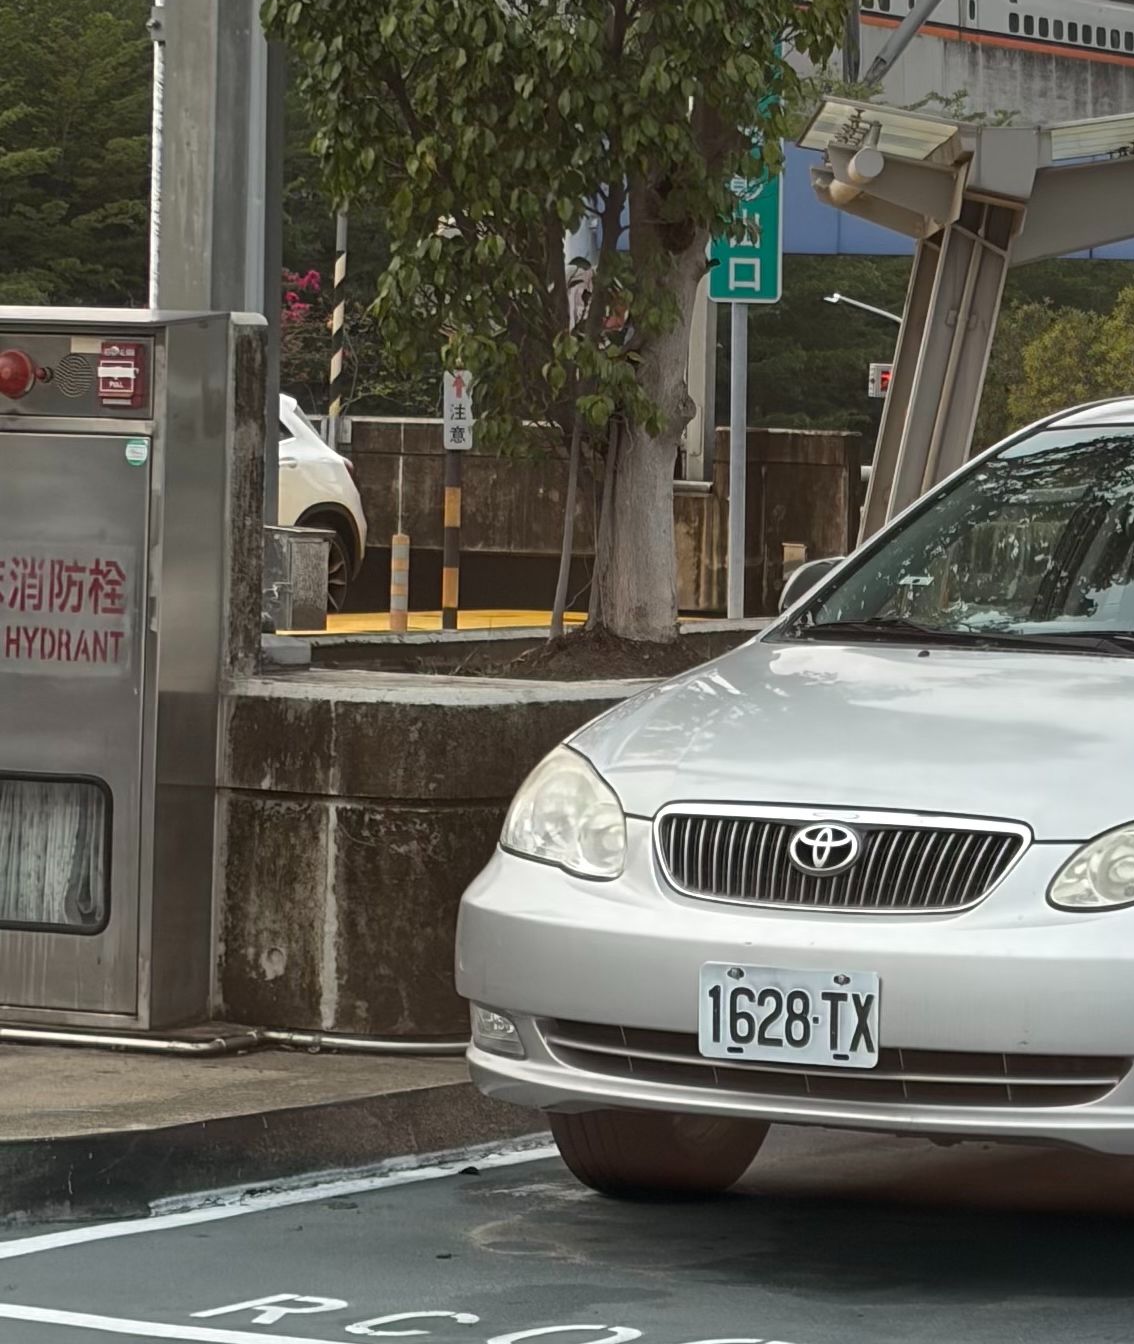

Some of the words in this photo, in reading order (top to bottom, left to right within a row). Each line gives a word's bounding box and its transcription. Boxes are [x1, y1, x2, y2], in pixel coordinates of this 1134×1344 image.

[449, 403, 467, 444] 注意
[0, 557, 126, 615] 消防栓
[5, 625, 125, 663] HYDRANT
